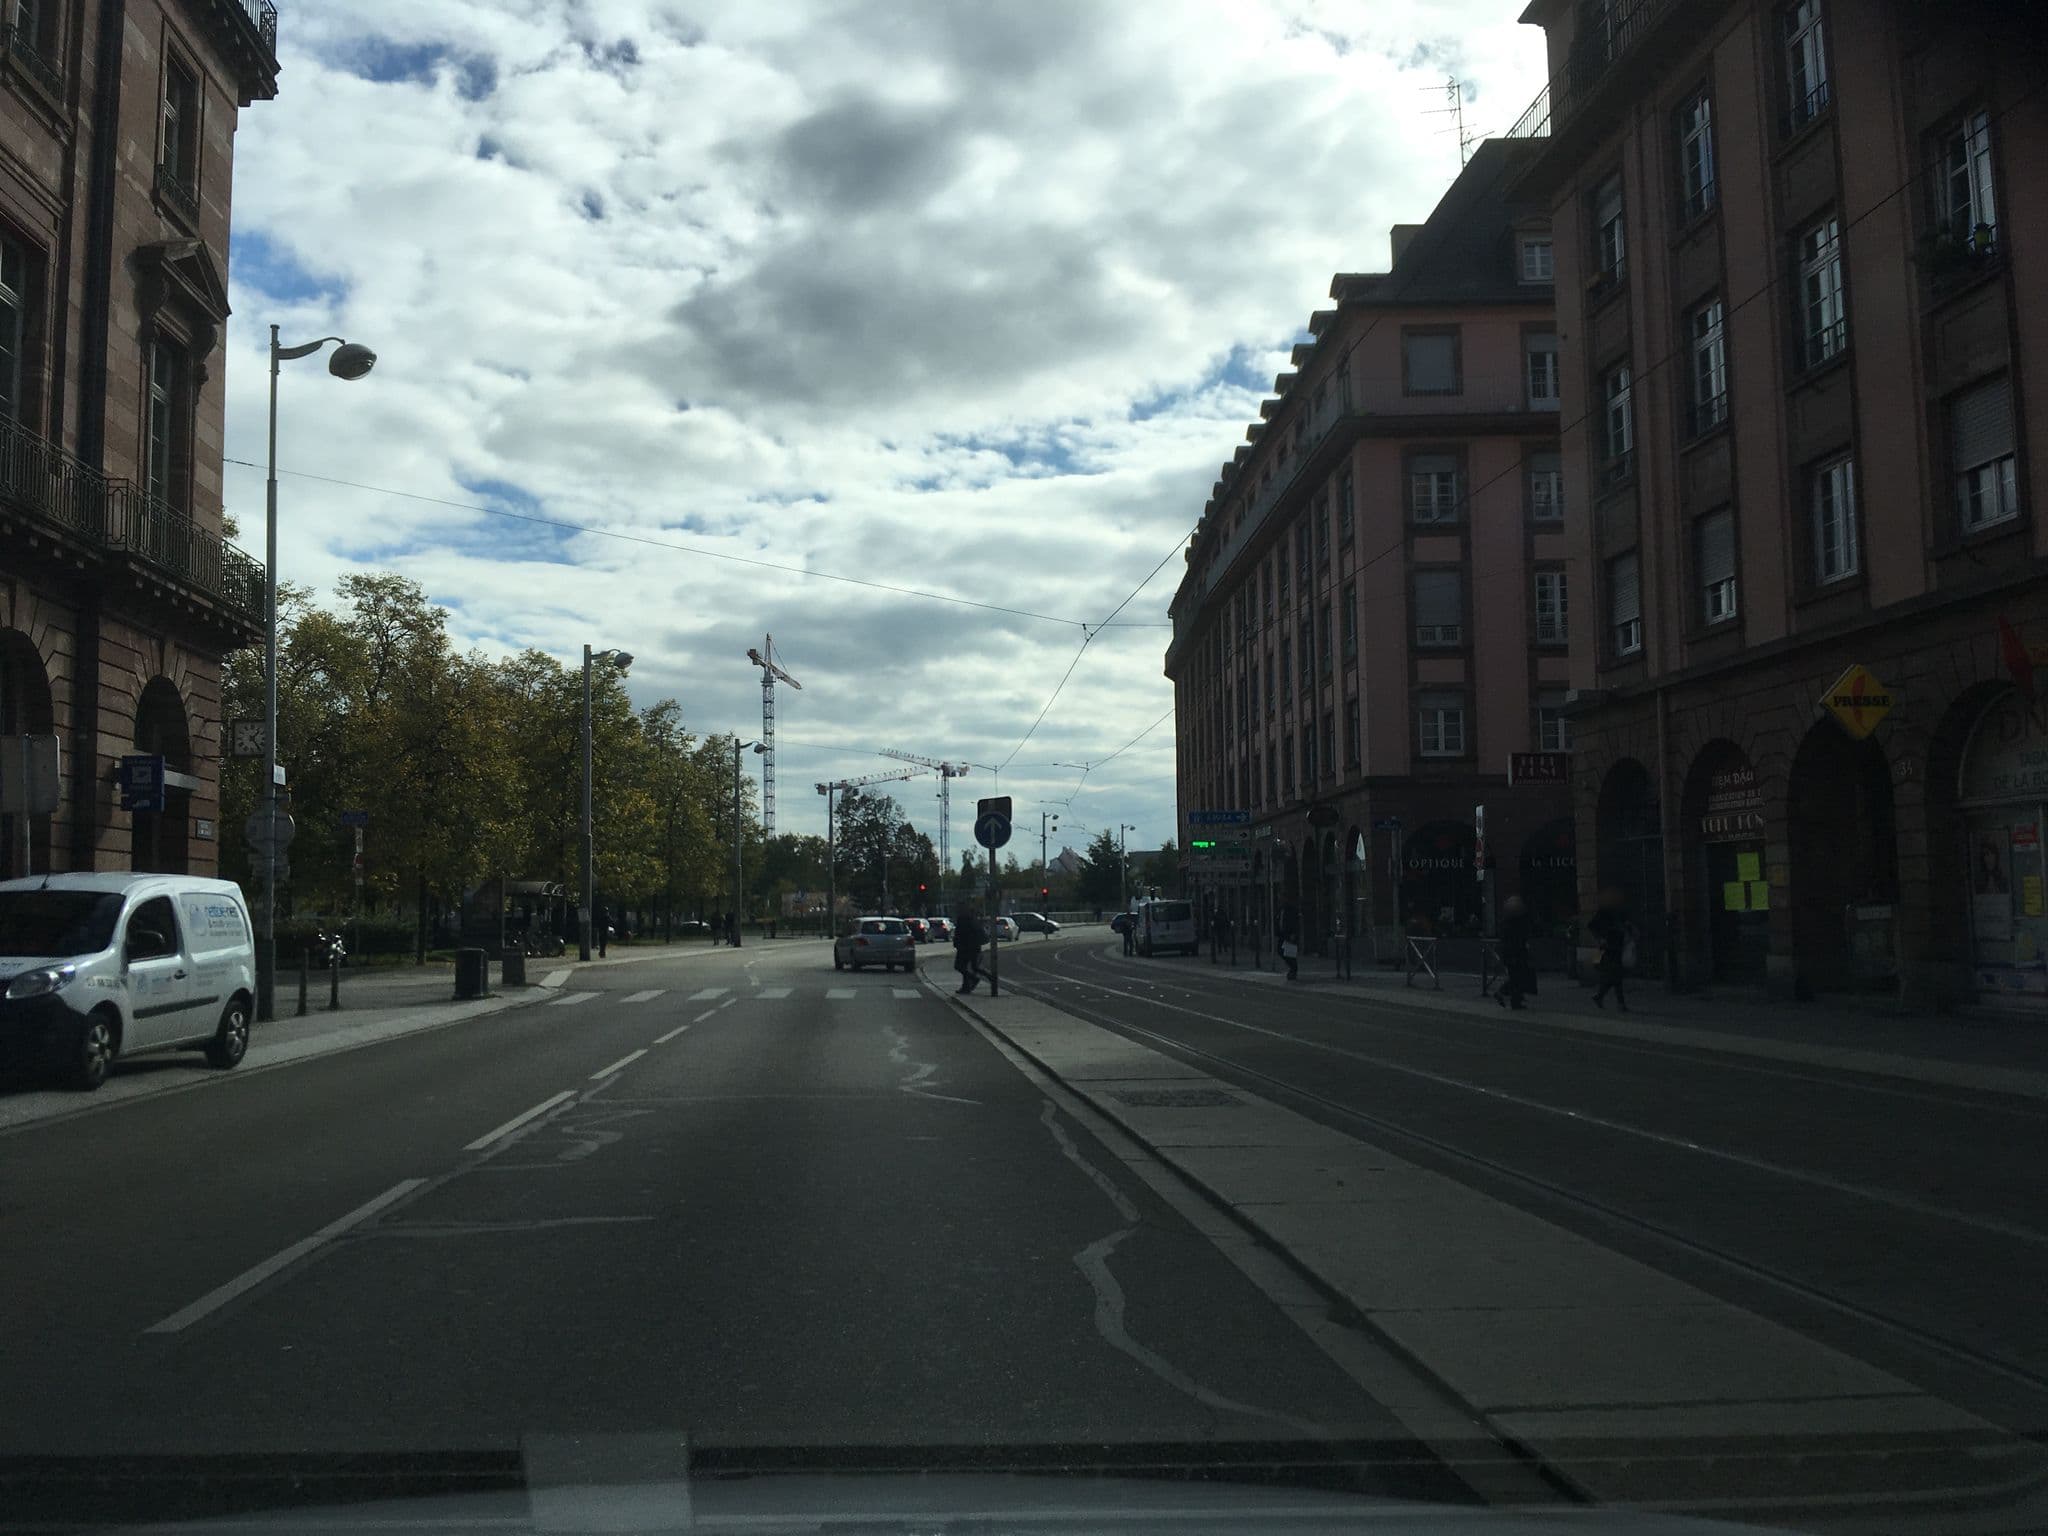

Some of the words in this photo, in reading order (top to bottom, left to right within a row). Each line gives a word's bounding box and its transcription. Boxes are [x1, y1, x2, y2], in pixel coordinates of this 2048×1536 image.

[1833, 694, 1890, 708] PRESSE
[2013, 774, 2028, 788] LA
[1409, 856, 1465, 869] OPTIQUE
